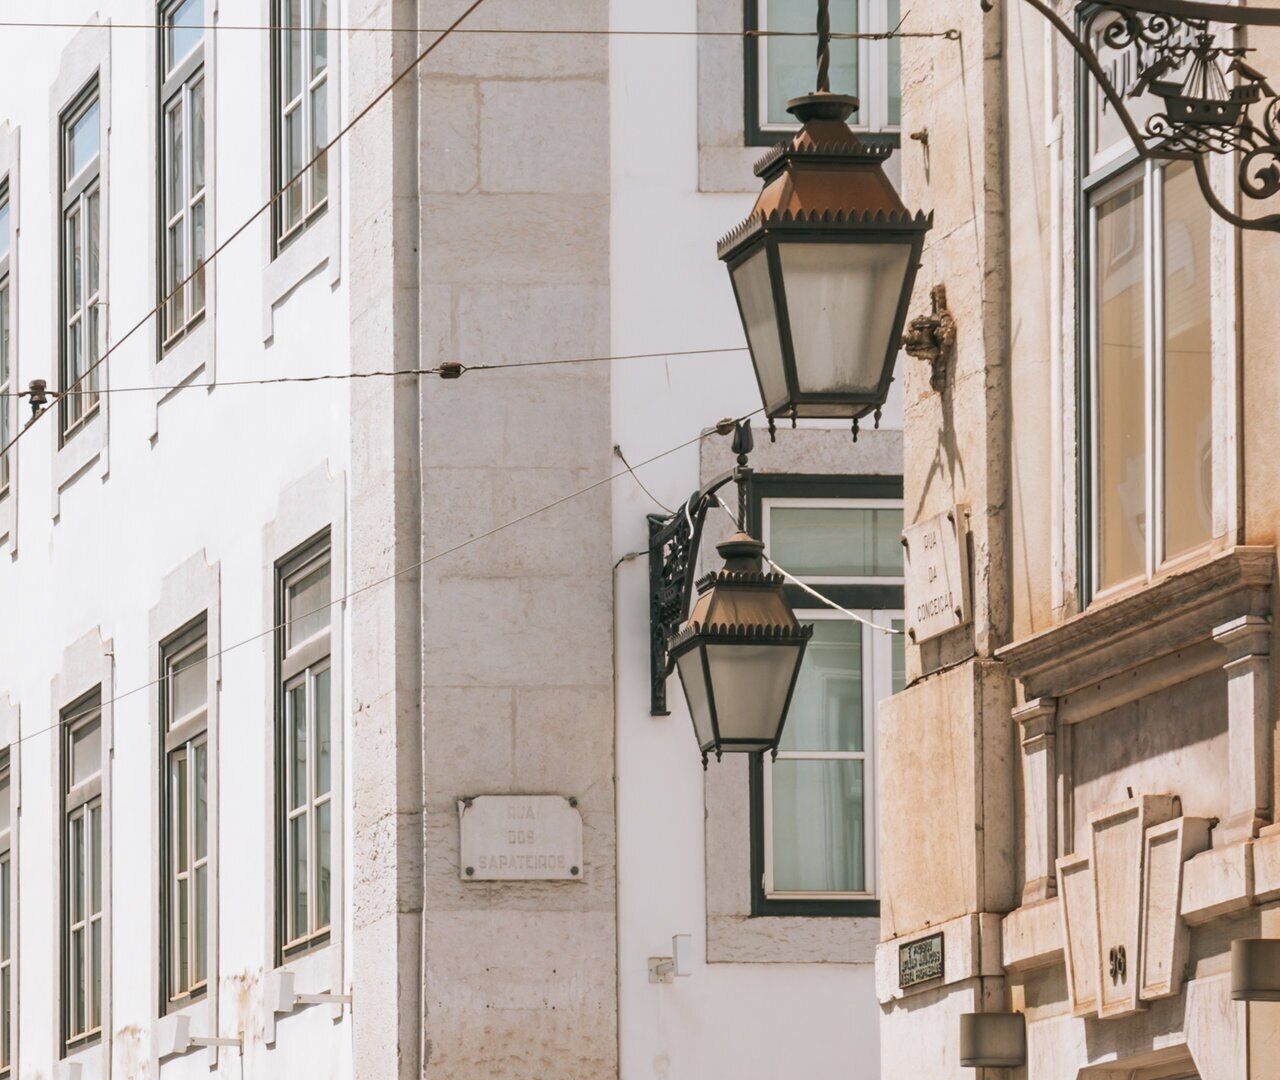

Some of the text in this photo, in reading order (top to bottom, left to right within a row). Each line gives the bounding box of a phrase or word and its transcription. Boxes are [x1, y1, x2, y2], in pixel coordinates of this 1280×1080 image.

[507, 805, 535, 820] RUA
[508, 830, 534, 845] DOS
[478, 855, 566, 870] SAPATEIROS
